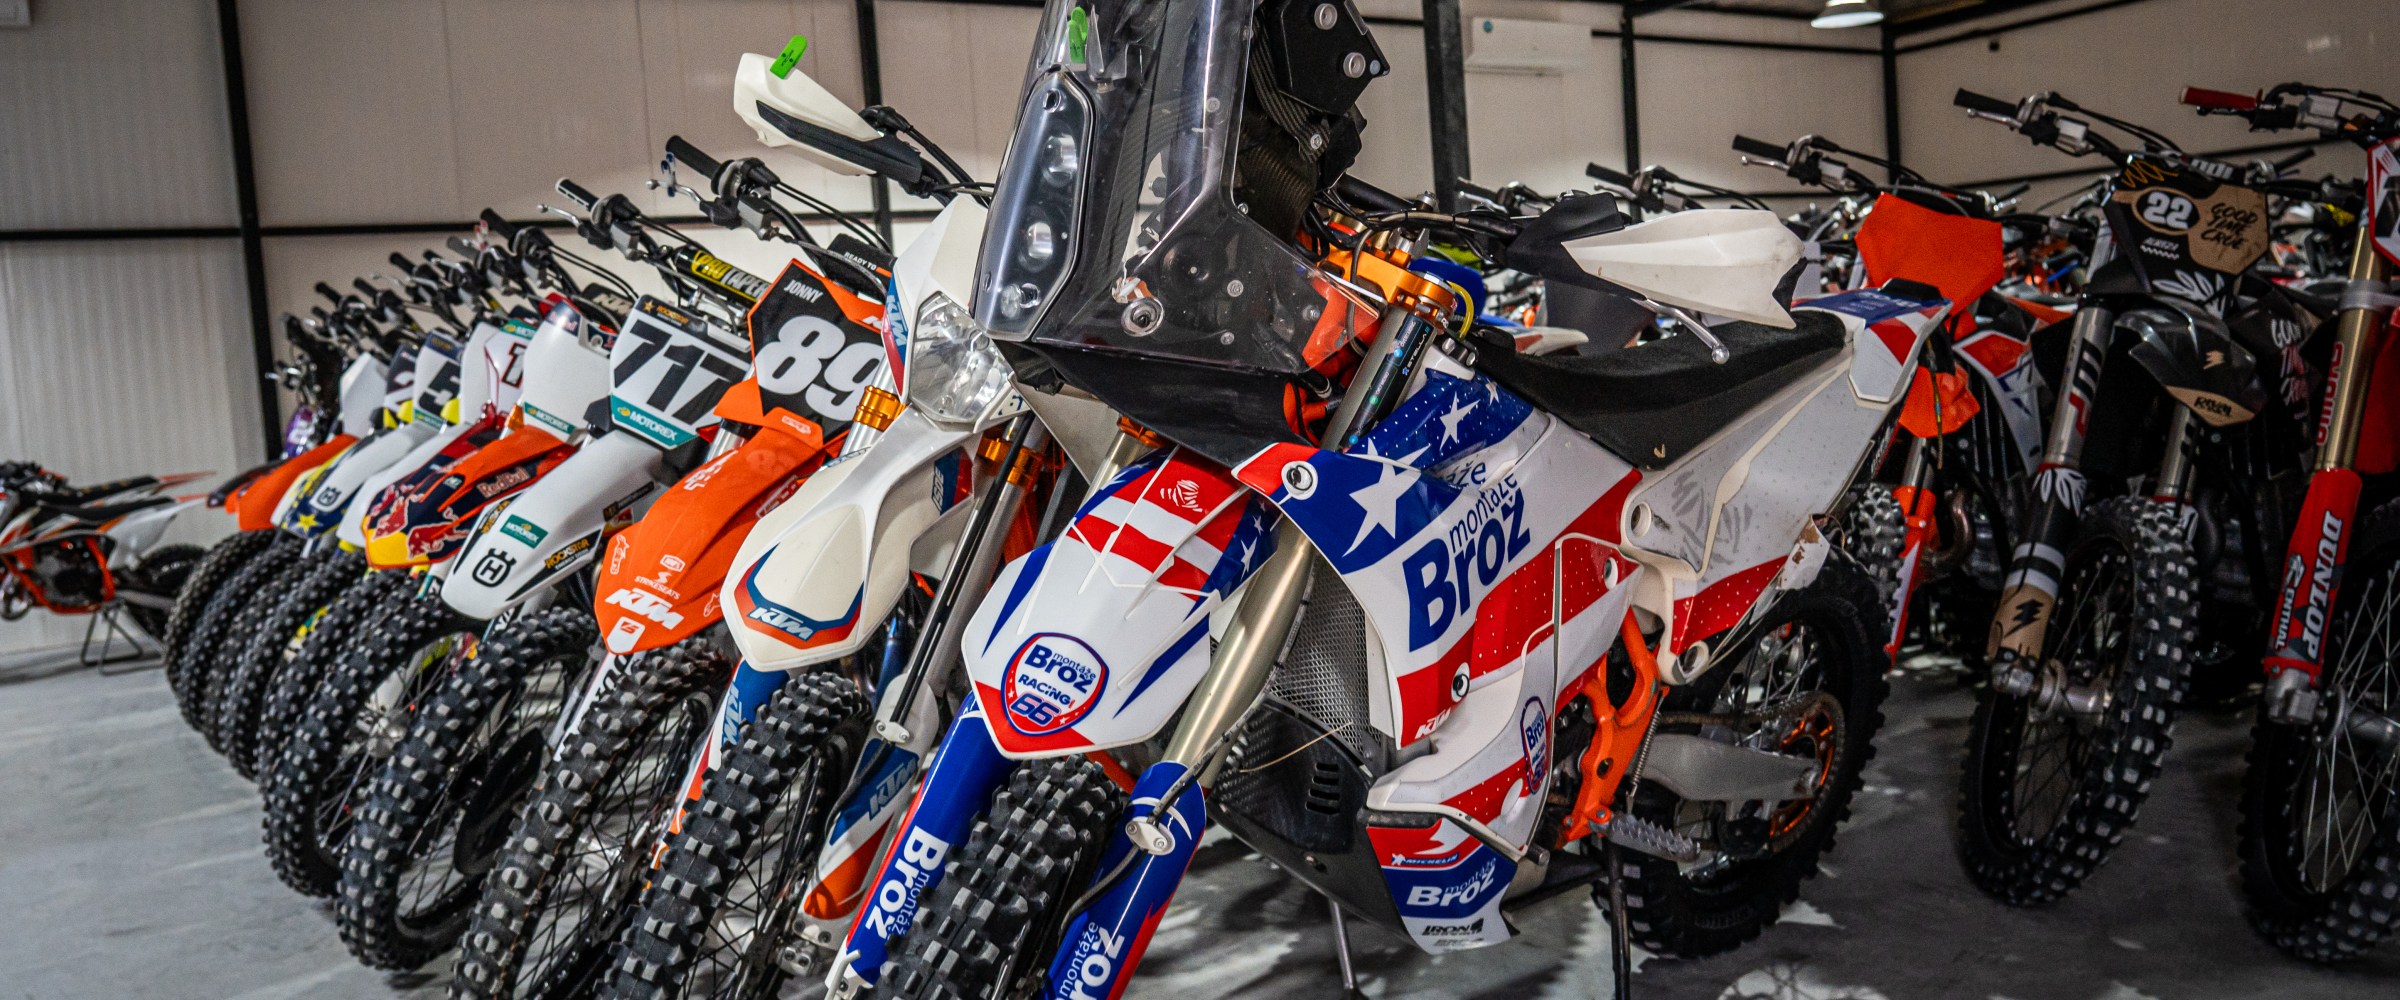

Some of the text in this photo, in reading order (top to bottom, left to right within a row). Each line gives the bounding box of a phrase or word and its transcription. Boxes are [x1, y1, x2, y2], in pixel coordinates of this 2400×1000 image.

[2144, 191, 2194, 230] 22
[2211, 203, 2258, 224] GOOD
[844, 251, 877, 271] READY TO
[783, 279, 824, 304] JONNY
[887, 294, 908, 347] KTM
[613, 319, 747, 426] 717
[754, 315, 886, 421] 89
[628, 410, 678, 442] MOTOREX
[544, 539, 590, 569] ROCKSTAR
[634, 575, 680, 600] STRIKESEATS
[2302, 510, 2343, 660] DUNLOP
[604, 587, 685, 631] KTM
[751, 606, 812, 642] KTM
[722, 682, 743, 746] KTM
[1010, 692, 1061, 726] 66
[1414, 705, 1451, 741] KTM
[868, 758, 920, 821] KTM
[1404, 853, 1459, 865] MICHELIN
[889, 871, 931, 937] montáž
[1422, 924, 1471, 936] IRON
